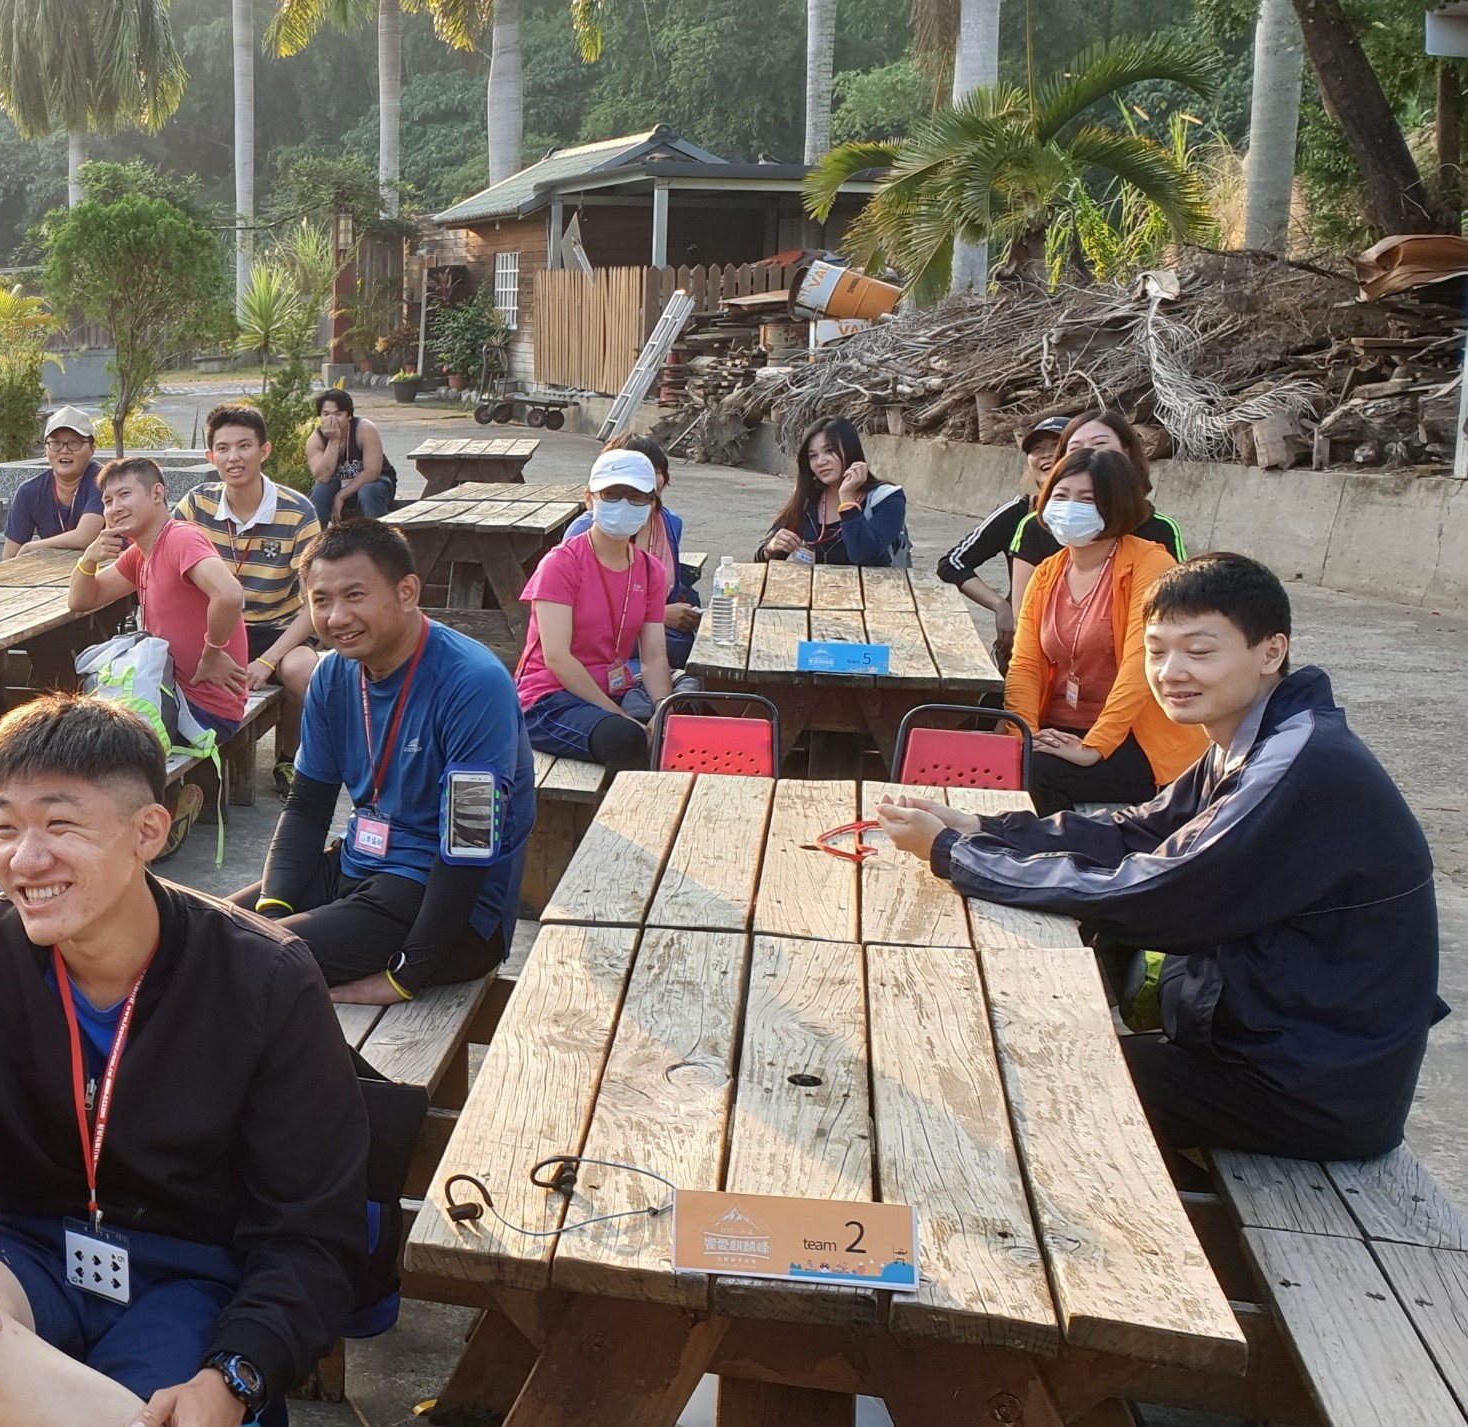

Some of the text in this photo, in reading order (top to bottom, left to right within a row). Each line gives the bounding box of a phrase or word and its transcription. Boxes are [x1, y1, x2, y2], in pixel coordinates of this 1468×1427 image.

[862, 652, 872, 665] 5
[803, 1220, 868, 1254] team 2
